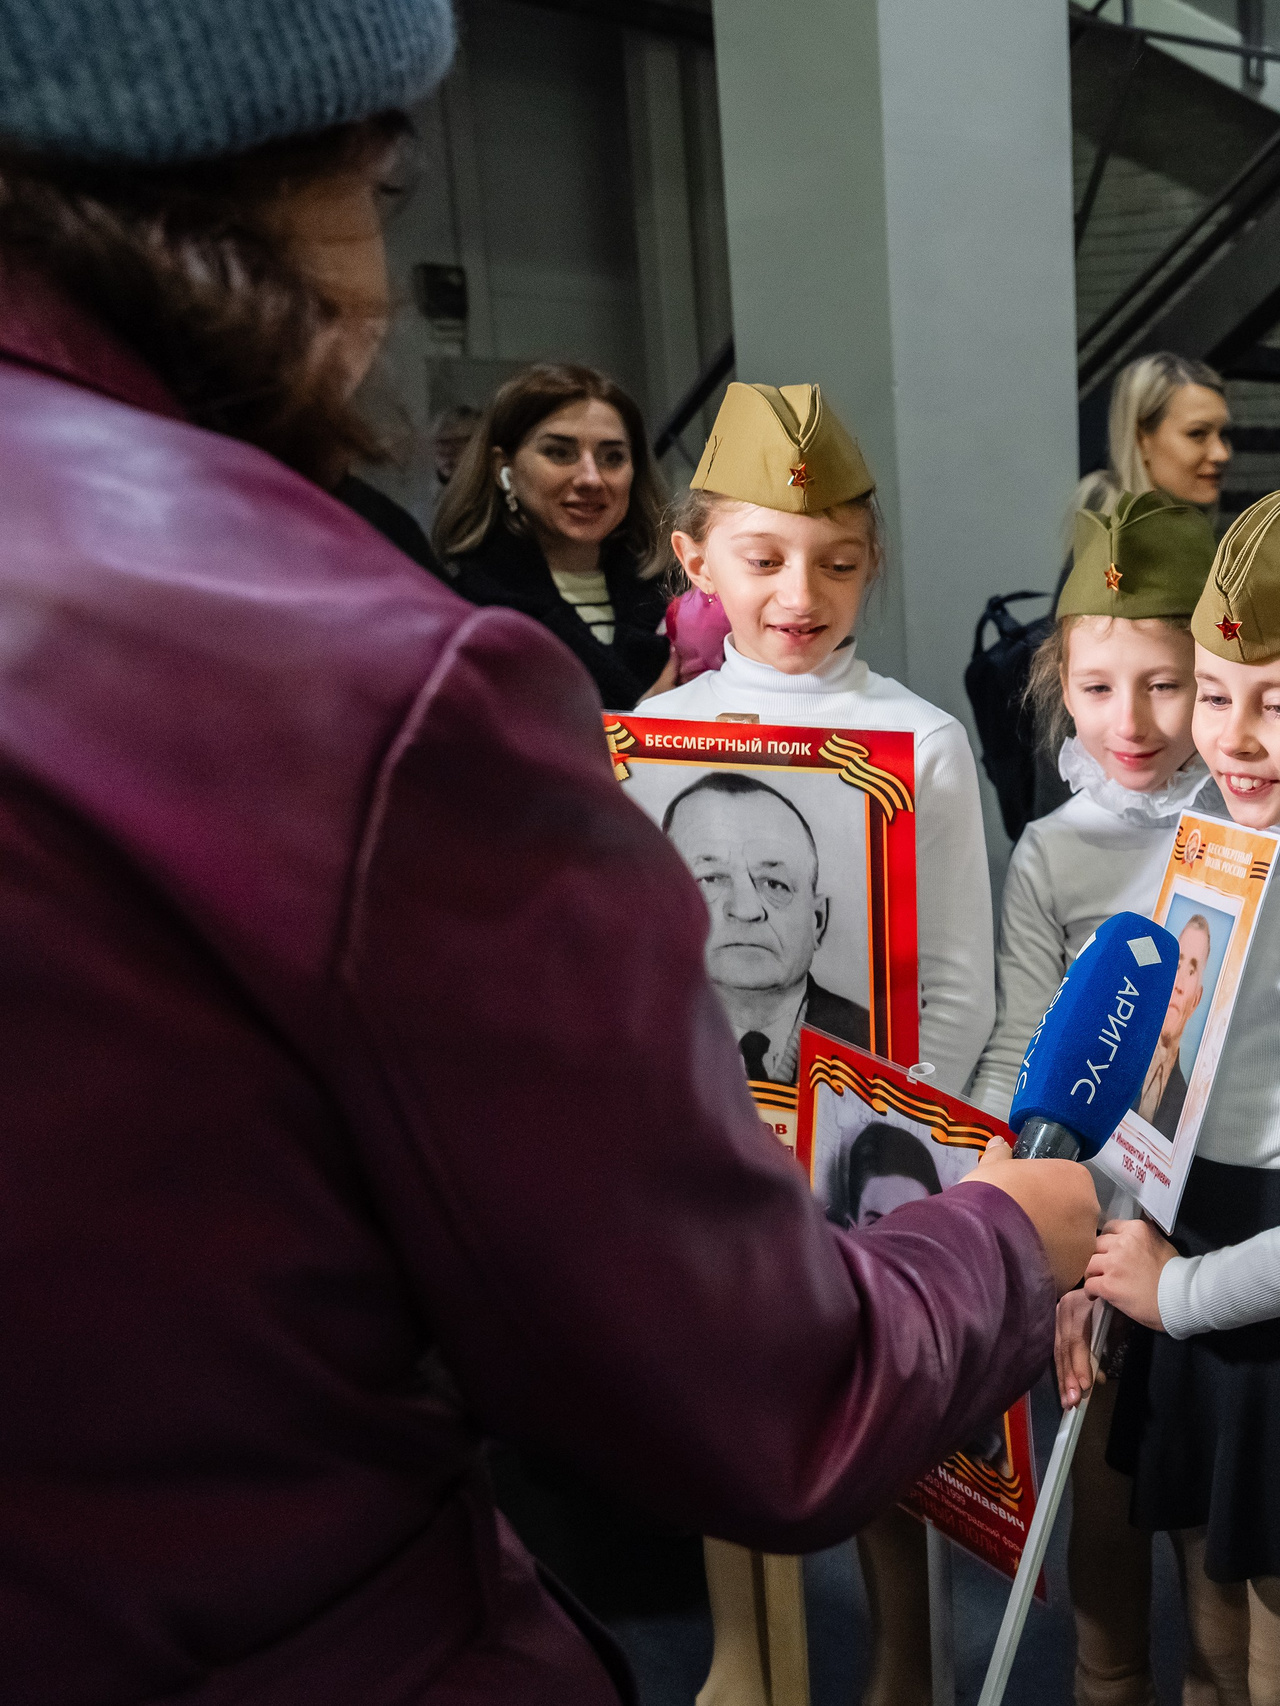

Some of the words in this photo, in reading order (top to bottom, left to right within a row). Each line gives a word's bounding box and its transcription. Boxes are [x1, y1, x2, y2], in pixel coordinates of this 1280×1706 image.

[644, 733, 763, 754] БЕССМЕРТНЫЙ
[767, 740, 813, 756] ПОЛК
[1070, 976, 1140, 1105] АРИГУС
[1115, 1131, 1145, 1164] Иннокентий
[937, 1465, 1025, 1532] Николаевич
